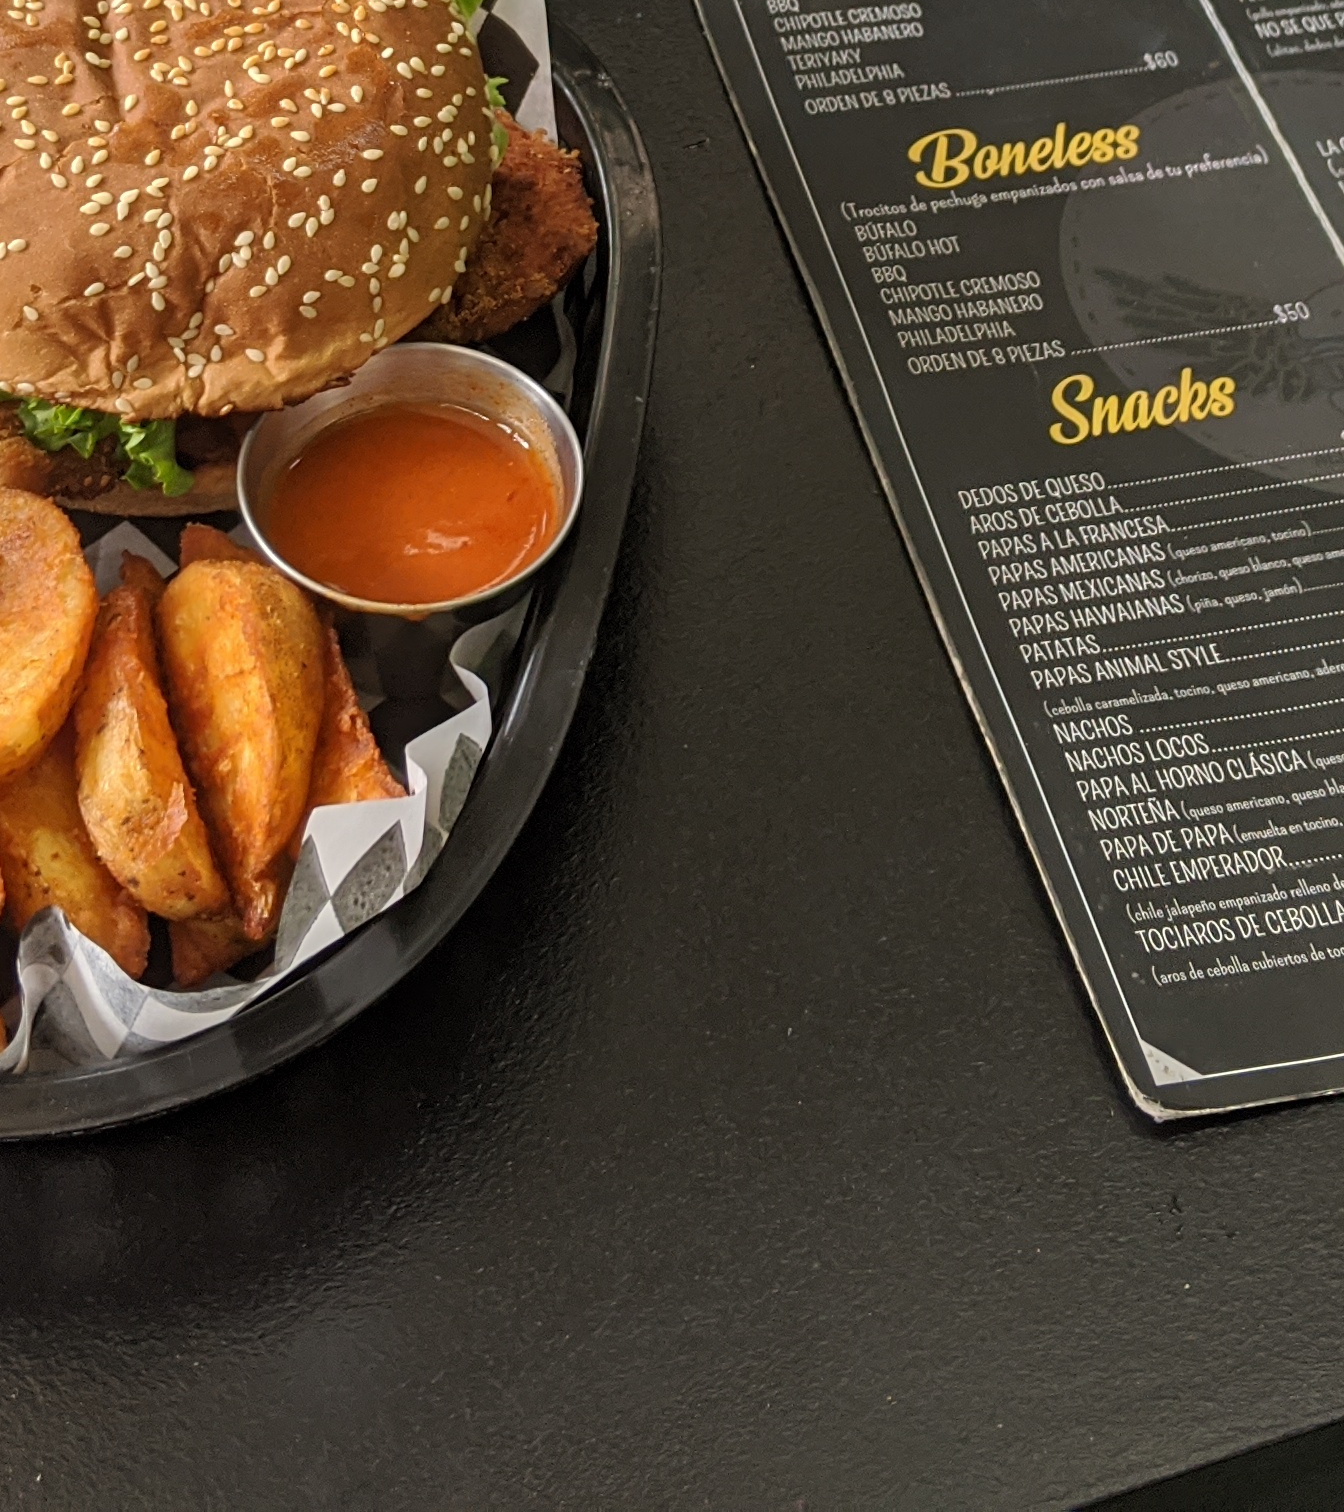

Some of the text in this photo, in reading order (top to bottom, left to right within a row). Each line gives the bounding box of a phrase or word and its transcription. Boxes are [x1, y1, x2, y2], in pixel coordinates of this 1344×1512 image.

[772, 1, 923, 33] CHIPOTLE CREMOSO
[778, 20, 925, 52] MANGO HABANERO
[785, 46, 861, 72] TERIYAKY
[793, 62, 905, 90] PHILADELPHIA
[803, 49, 1179, 115] ORDEN DE 8 PIEZAS $60
[906, 122, 1141, 190] Boneless
[853, 218, 918, 242] BÚFALO
[861, 234, 961, 263] BÚFALO HOT
[869, 263, 908, 284] BBQ
[878, 269, 1041, 304] CHIPOTLE CREMOSO
[886, 291, 1044, 327] MANGO HABANERO
[896, 319, 1017, 349] PHILADELPHIA
[906, 300, 1310, 375] ORDEN DE 8 PIEZAS $50
[1047, 367, 1237, 446] Snacks
[956, 482, 1019, 510] DEDOS
[1017, 479, 1046, 501] DE
[1043, 470, 1106, 498] QUESO
[969, 509, 1018, 535] AROS
[1017, 505, 1046, 528] DE
[1043, 494, 1124, 523] CEBOLLA
[976, 532, 1038, 560] PAPAS
[1039, 531, 1055, 552] A
[1052, 527, 1080, 549] LA
[1077, 513, 1171, 545] FRANCESA
[986, 558, 1048, 586] PAPAS
[1049, 540, 1166, 577] AMERICANAS
[997, 584, 1059, 612] PAPAS
[1057, 568, 1166, 603] MEXICANAS
[1007, 610, 1070, 638] PAPAS
[1068, 592, 1185, 628] HAWAIANAS
[1018, 633, 1101, 664] PATATAS
[1029, 662, 1092, 690] PAPAS
[1093, 651, 1169, 682] ANIMAL
[1166, 642, 1226, 670] STYLE
[1051, 713, 1134, 744] NACHOS
[1063, 741, 1145, 773] NACHOS
[1143, 731, 1210, 762] LOCOS
[1075, 774, 1130, 802] PAPA
[1129, 770, 1157, 795] AL
[1153, 759, 1225, 791] HORNO
[1225, 748, 1308, 781] CLÁSICA
[1086, 796, 1181, 831] NORTEÑA
[1098, 833, 1154, 861] PAPA
[1150, 828, 1182, 854] DE
[1179, 821, 1235, 850] PAPA
[1112, 862, 1172, 892] CHILE
[1168, 844, 1288, 884] EMPERADOR
[1133, 917, 1236, 953] TOCIAROS
[1233, 912, 1266, 939] DE
